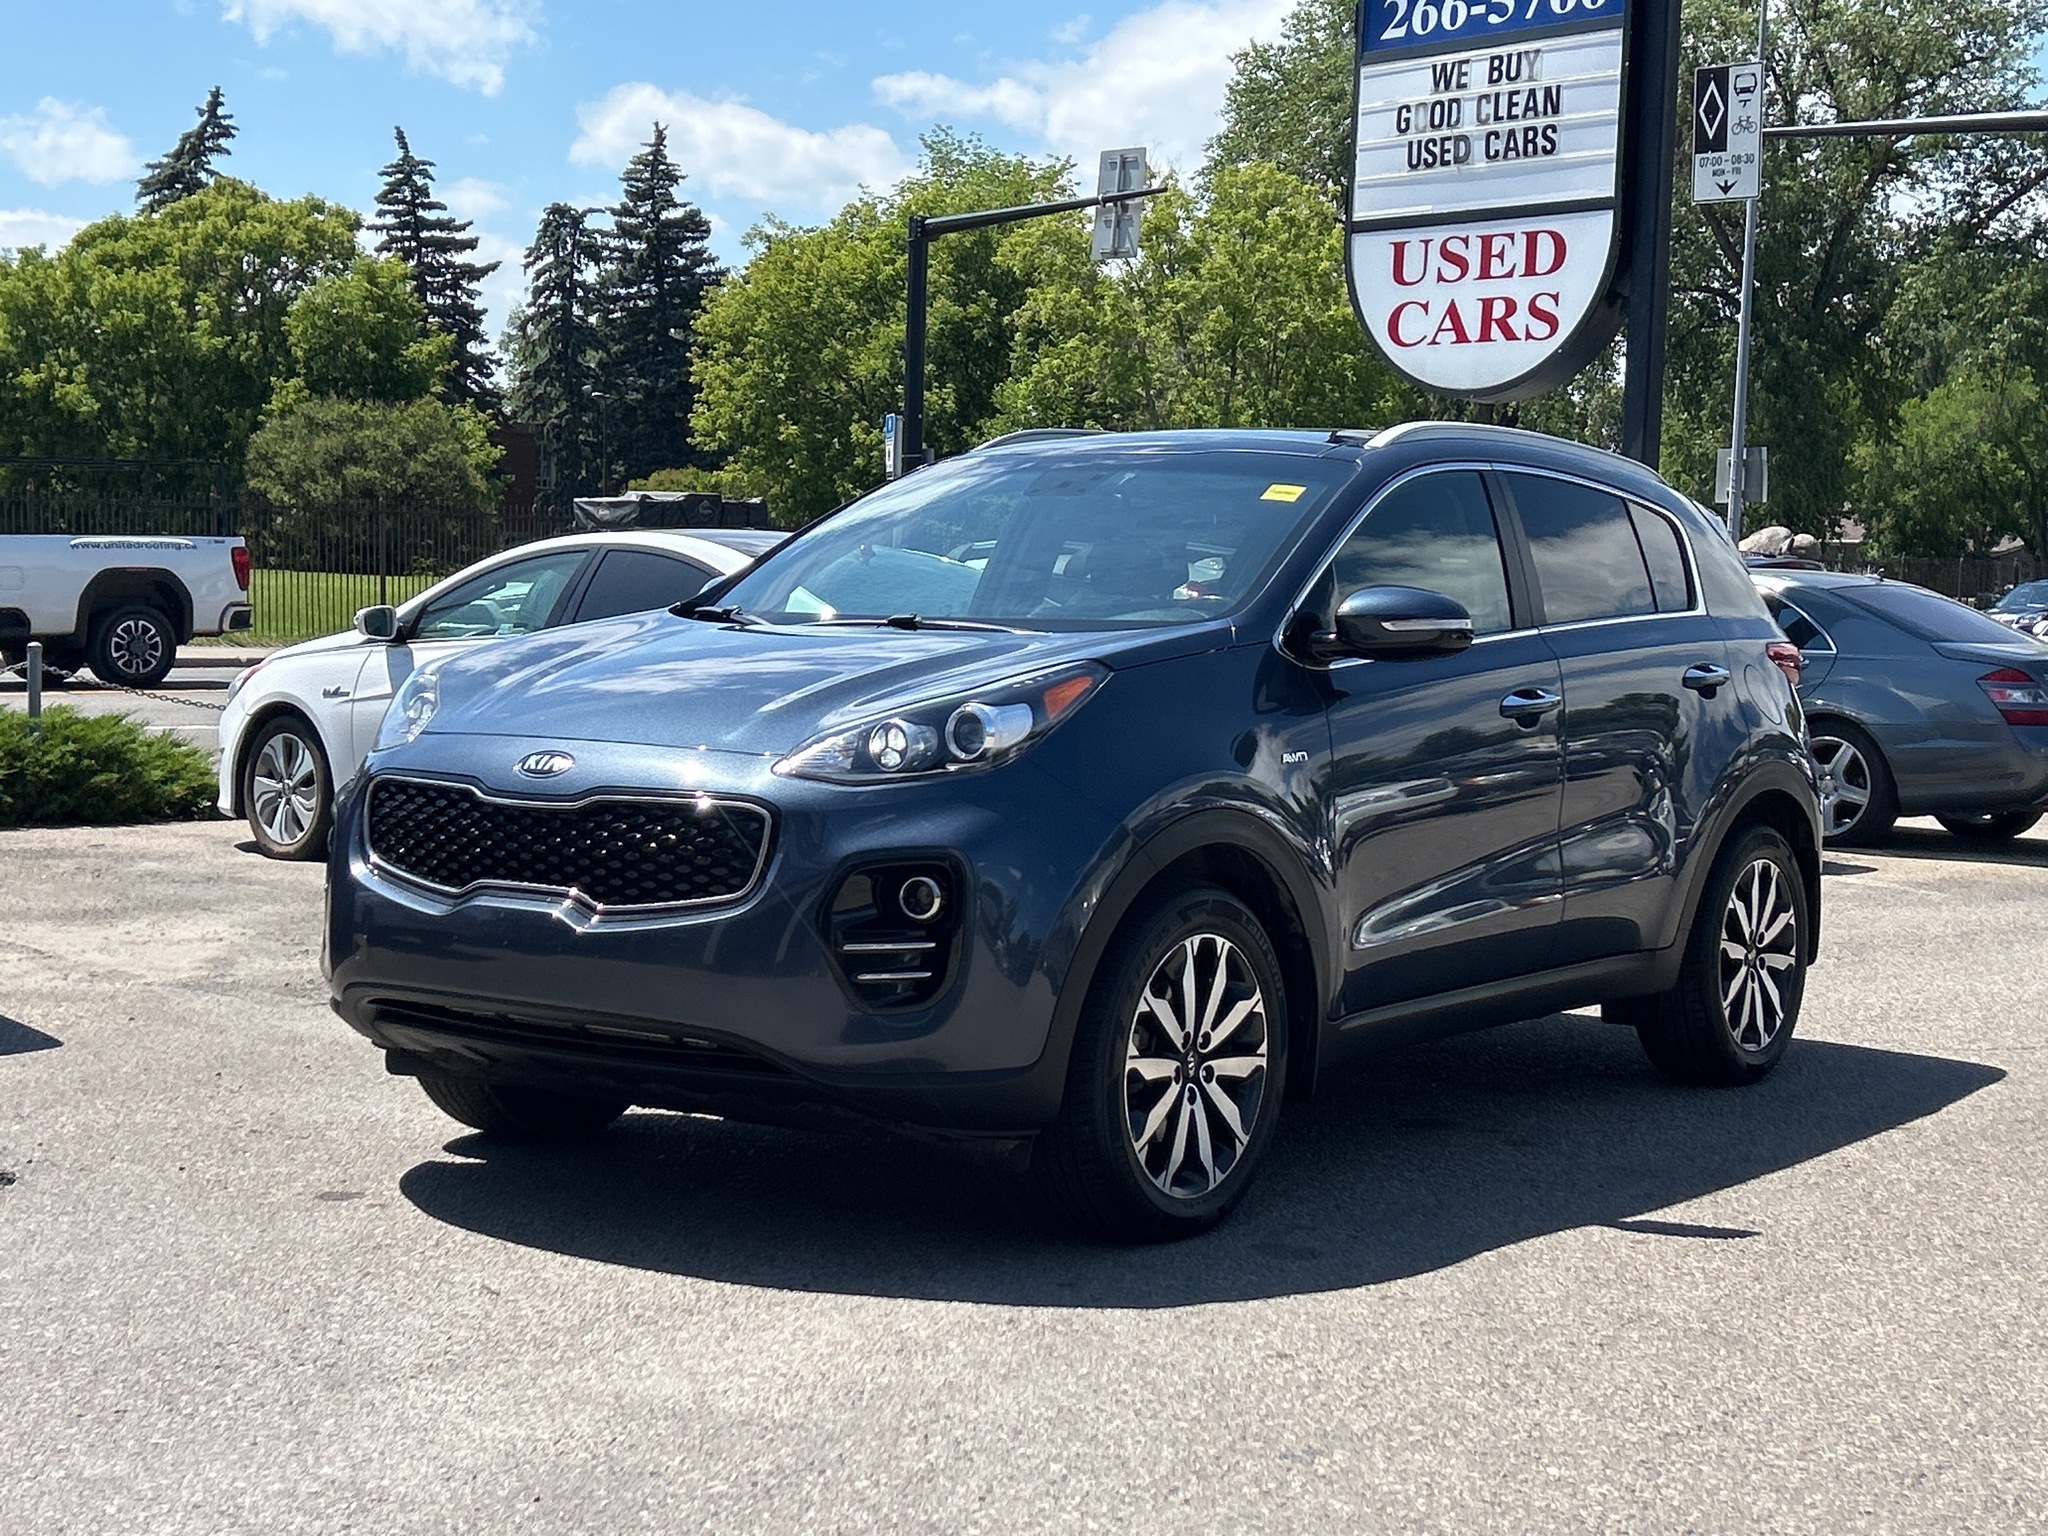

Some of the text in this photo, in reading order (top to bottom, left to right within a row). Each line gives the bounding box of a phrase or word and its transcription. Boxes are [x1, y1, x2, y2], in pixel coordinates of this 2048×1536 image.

[1380, 0, 1605, 40] 266-5
[1431, 49, 1541, 91] WE BUY
[1396, 84, 1561, 133] GOOD CLEAN
[1407, 124, 1557, 169] USED CARS
[1699, 156, 1723, 168] 07:00
[1389, 230, 1567, 286] USED
[1387, 292, 1560, 348] CARS
[523, 754, 567, 771] KIA
